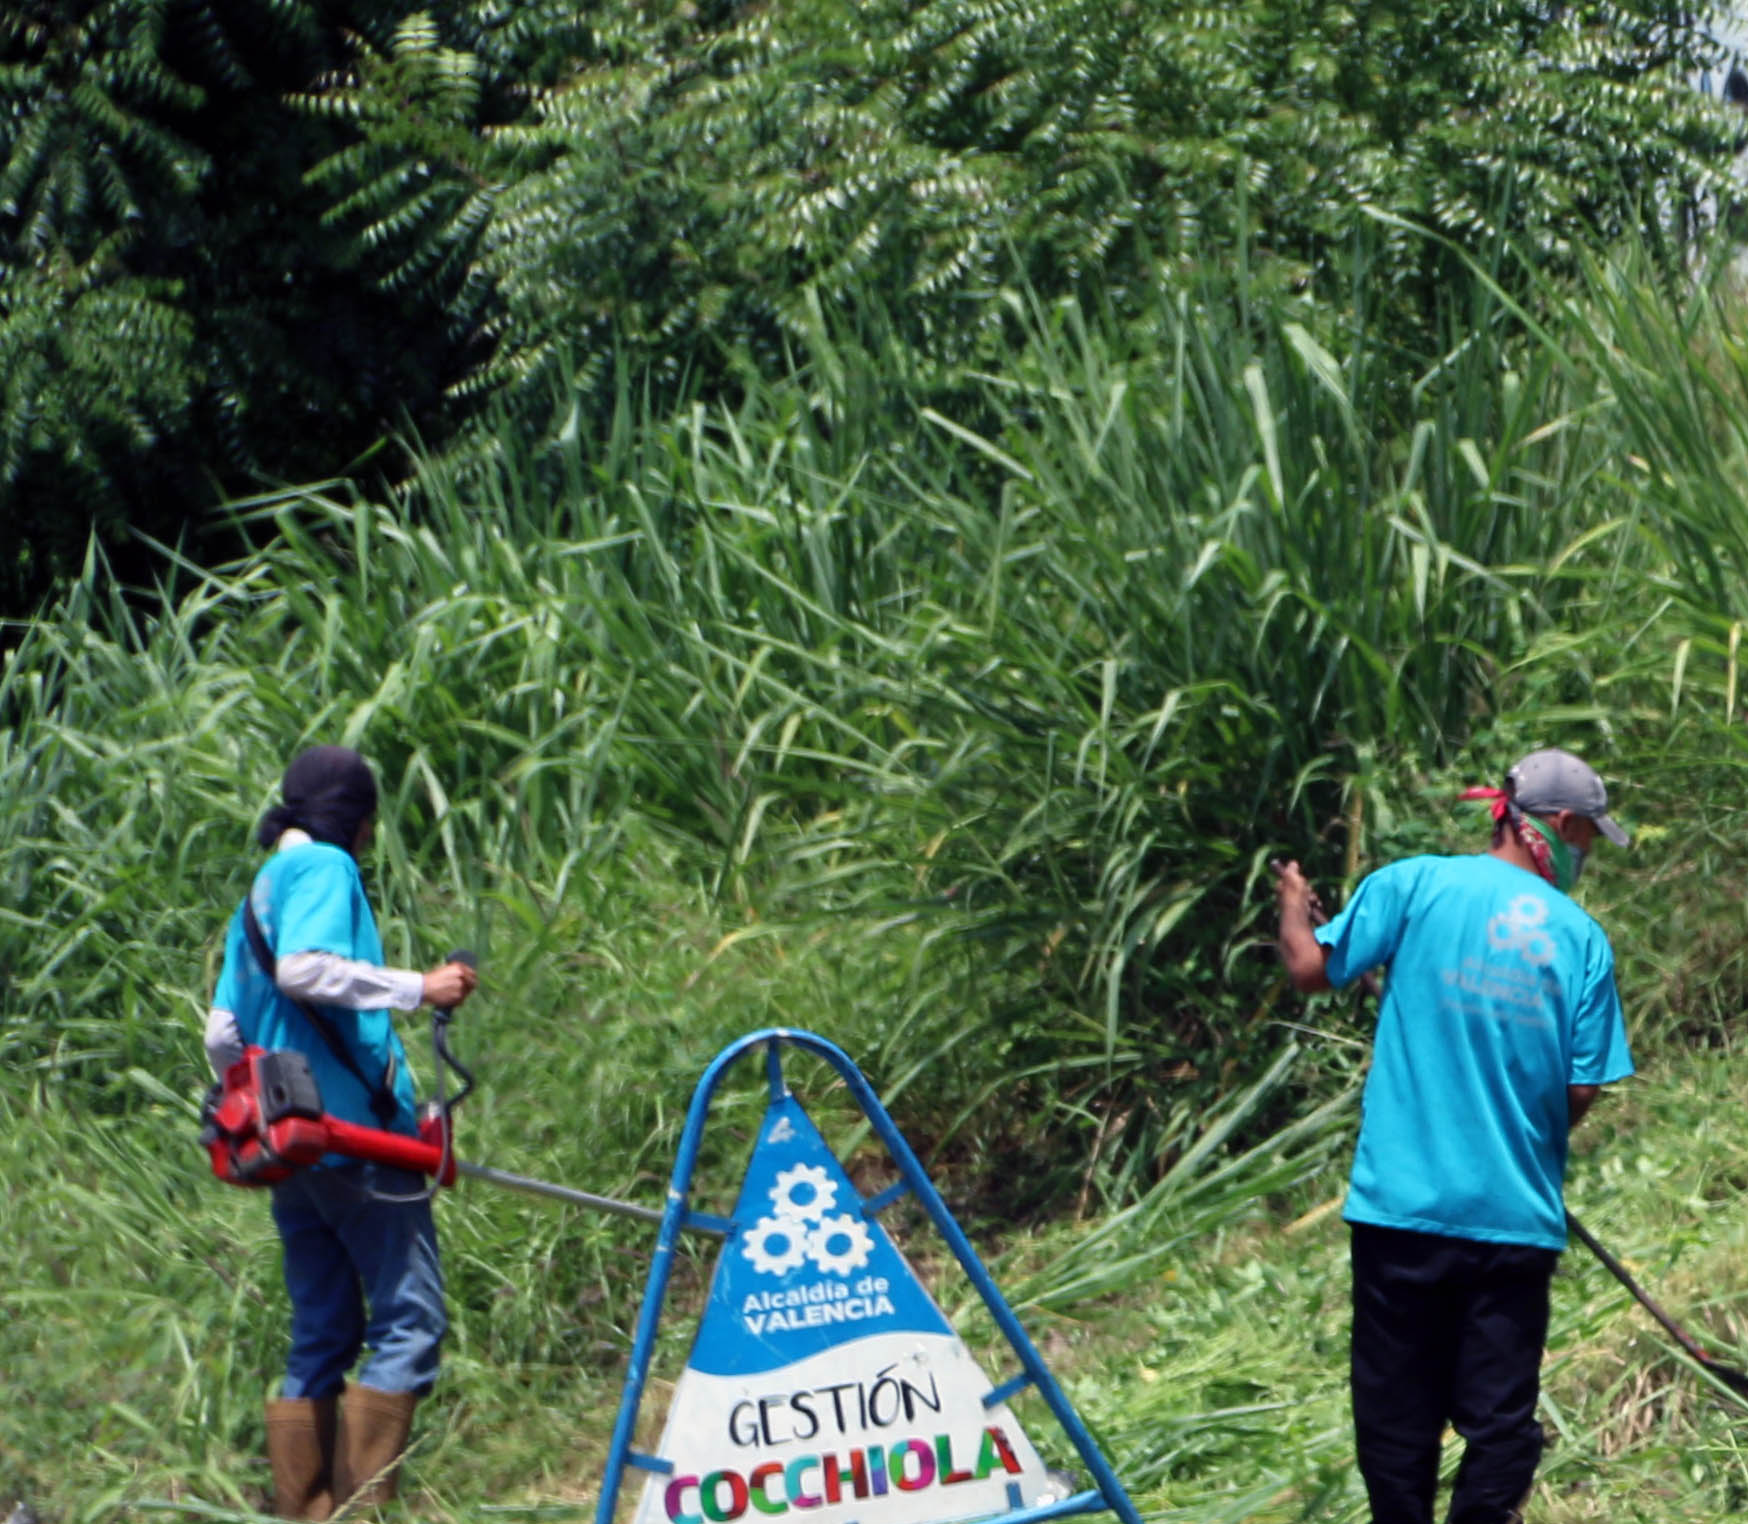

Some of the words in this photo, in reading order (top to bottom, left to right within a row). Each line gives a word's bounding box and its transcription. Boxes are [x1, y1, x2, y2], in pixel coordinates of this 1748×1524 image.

[743, 1279, 849, 1314] Alcaldía
[856, 1275, 890, 1296] de
[743, 1294, 895, 1336] VALENCIA
[728, 1363, 942, 1449] GESTIÓN
